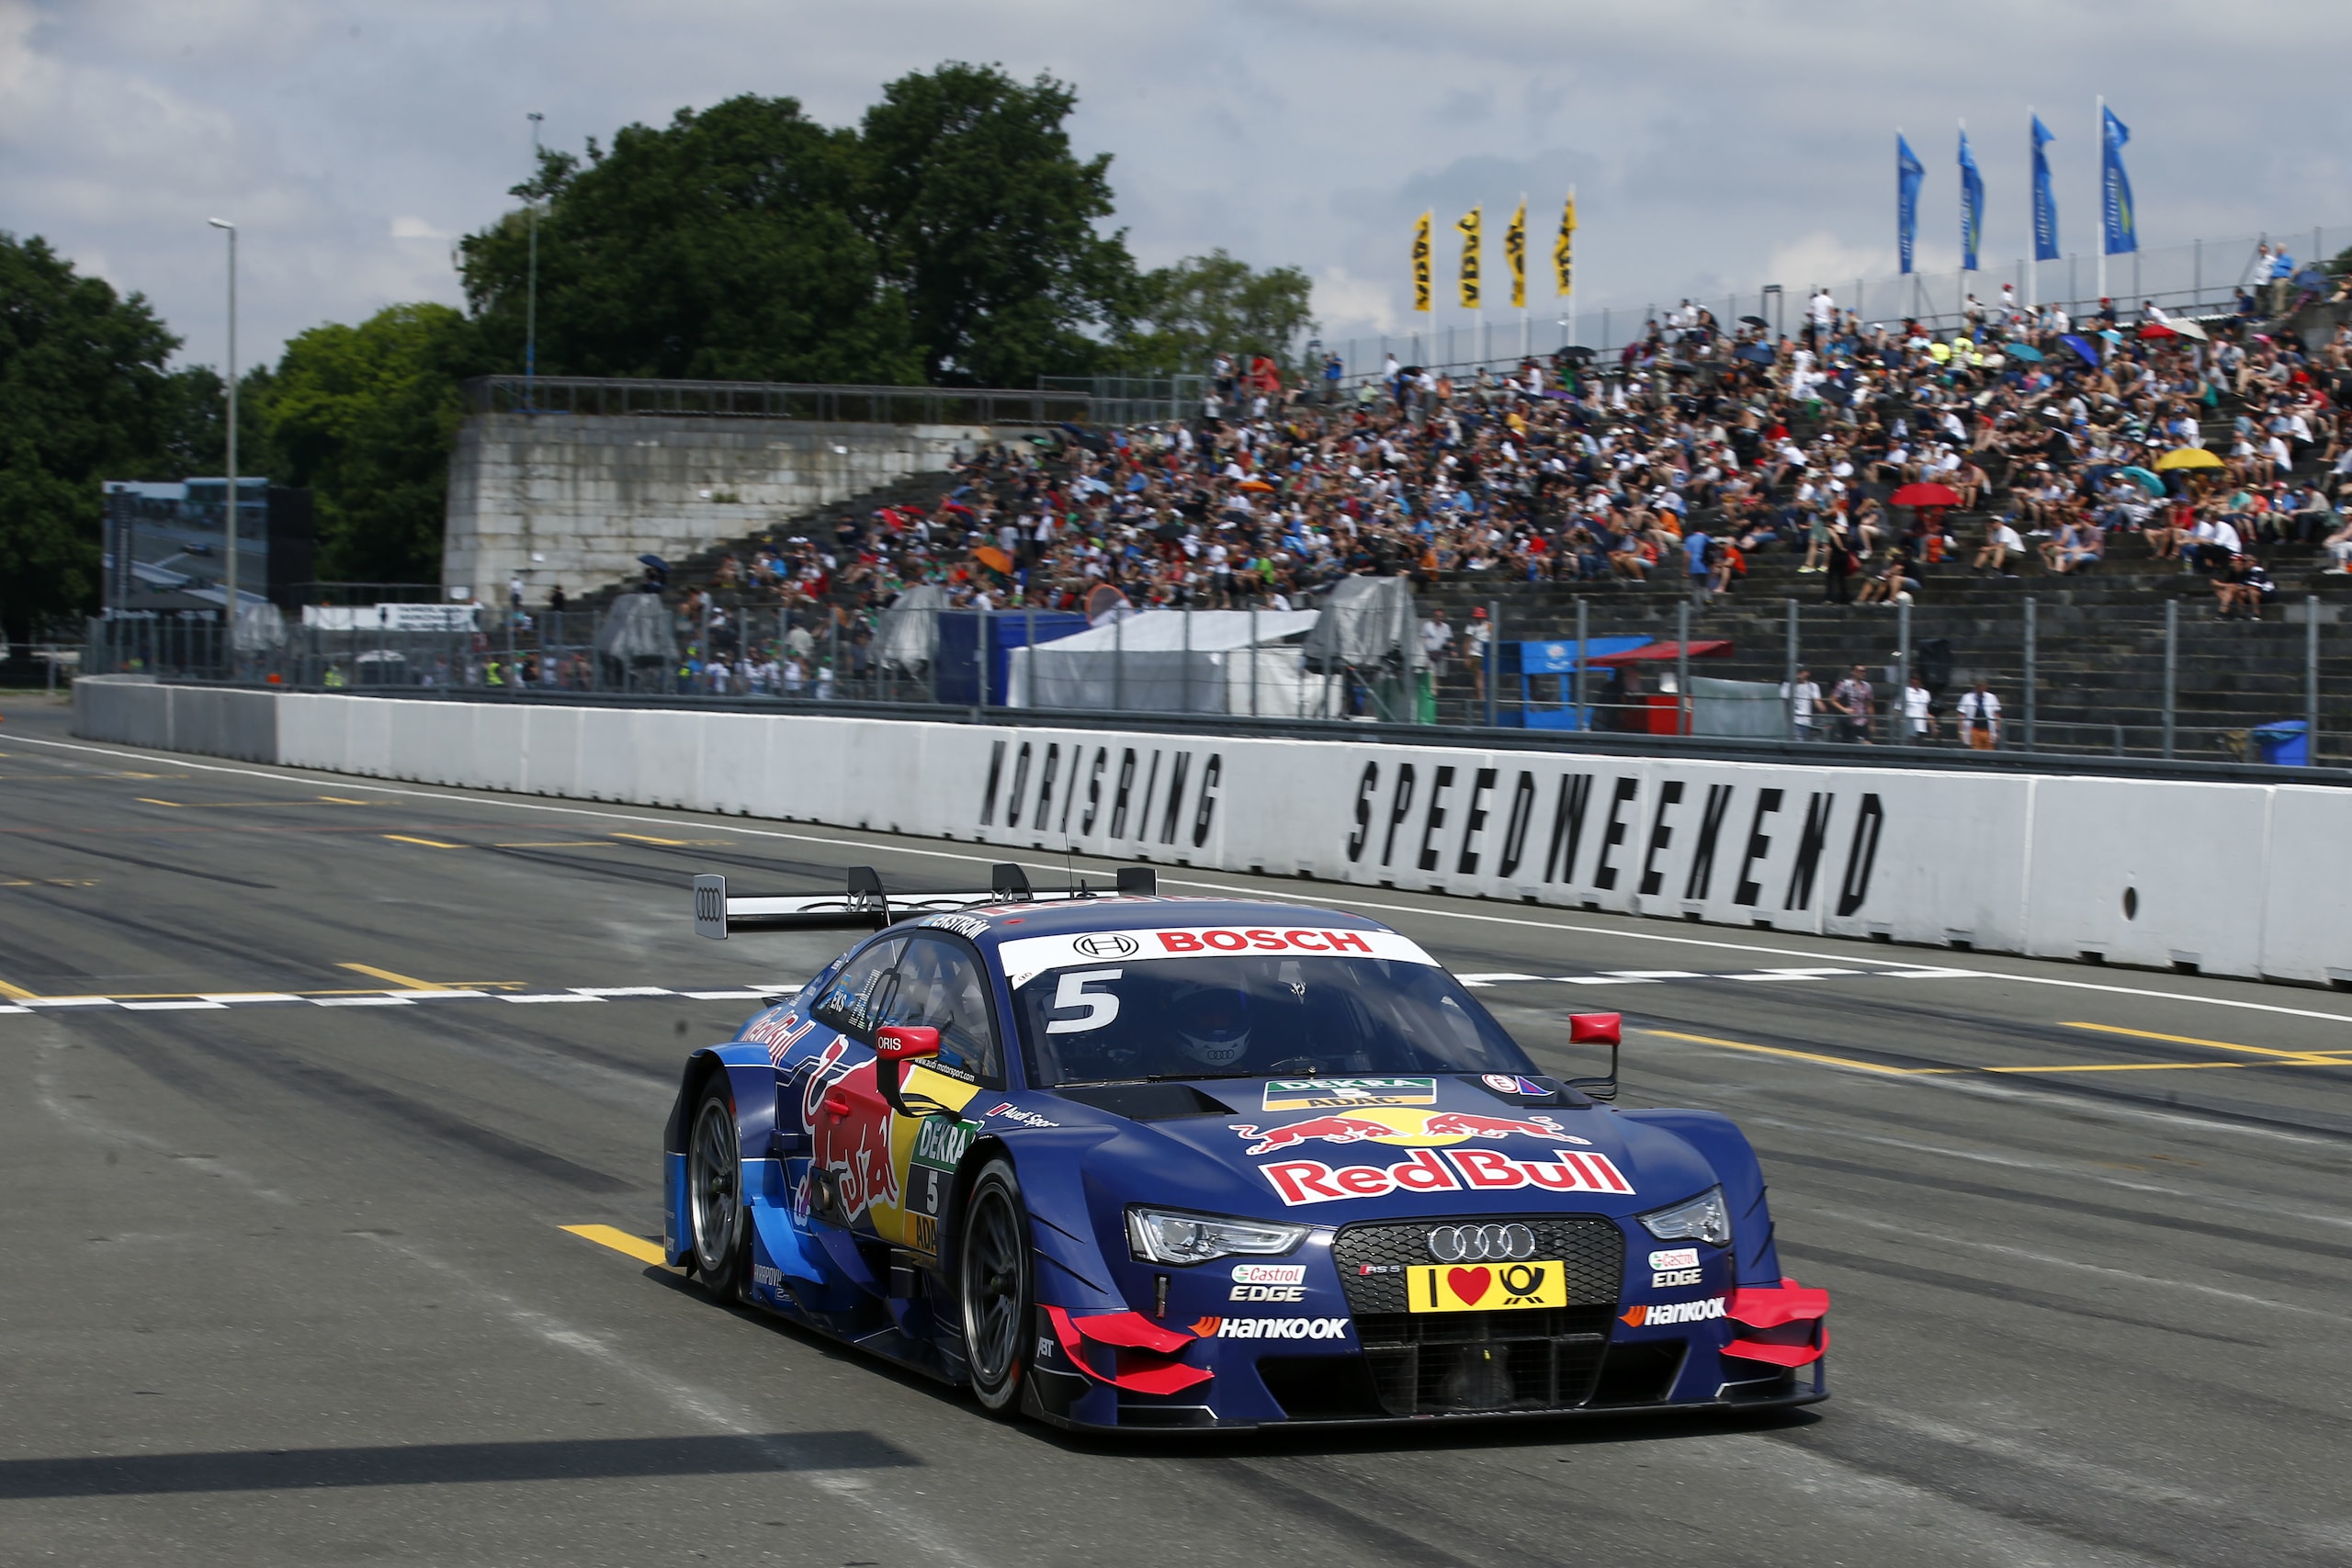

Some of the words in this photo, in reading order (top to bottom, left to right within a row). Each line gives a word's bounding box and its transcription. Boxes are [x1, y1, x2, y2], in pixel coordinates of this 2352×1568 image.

[979, 739, 1222, 848] NORISRING
[1347, 761, 1884, 917] SPEEDWEEKEND
[1156, 930, 1374, 953] BOSCH
[830, 990, 847, 1012] EKS
[1046, 969, 1124, 1034] 5
[877, 1036, 901, 1051] ORIS
[1276, 1078, 1427, 1089] DEKRA
[1306, 1096, 1403, 1107] ADAC
[1002, 1107, 1034, 1122] Audi
[919, 1120, 967, 1164] DEKRA
[1262, 1150, 1459, 1204] Red
[1445, 1149, 1633, 1194] Bull
[926, 1169, 939, 1213] 5
[1250, 1267, 1300, 1281] Castrol
[1652, 1269, 1703, 1288] EDGE
[1228, 1286, 1308, 1302] EDGE
